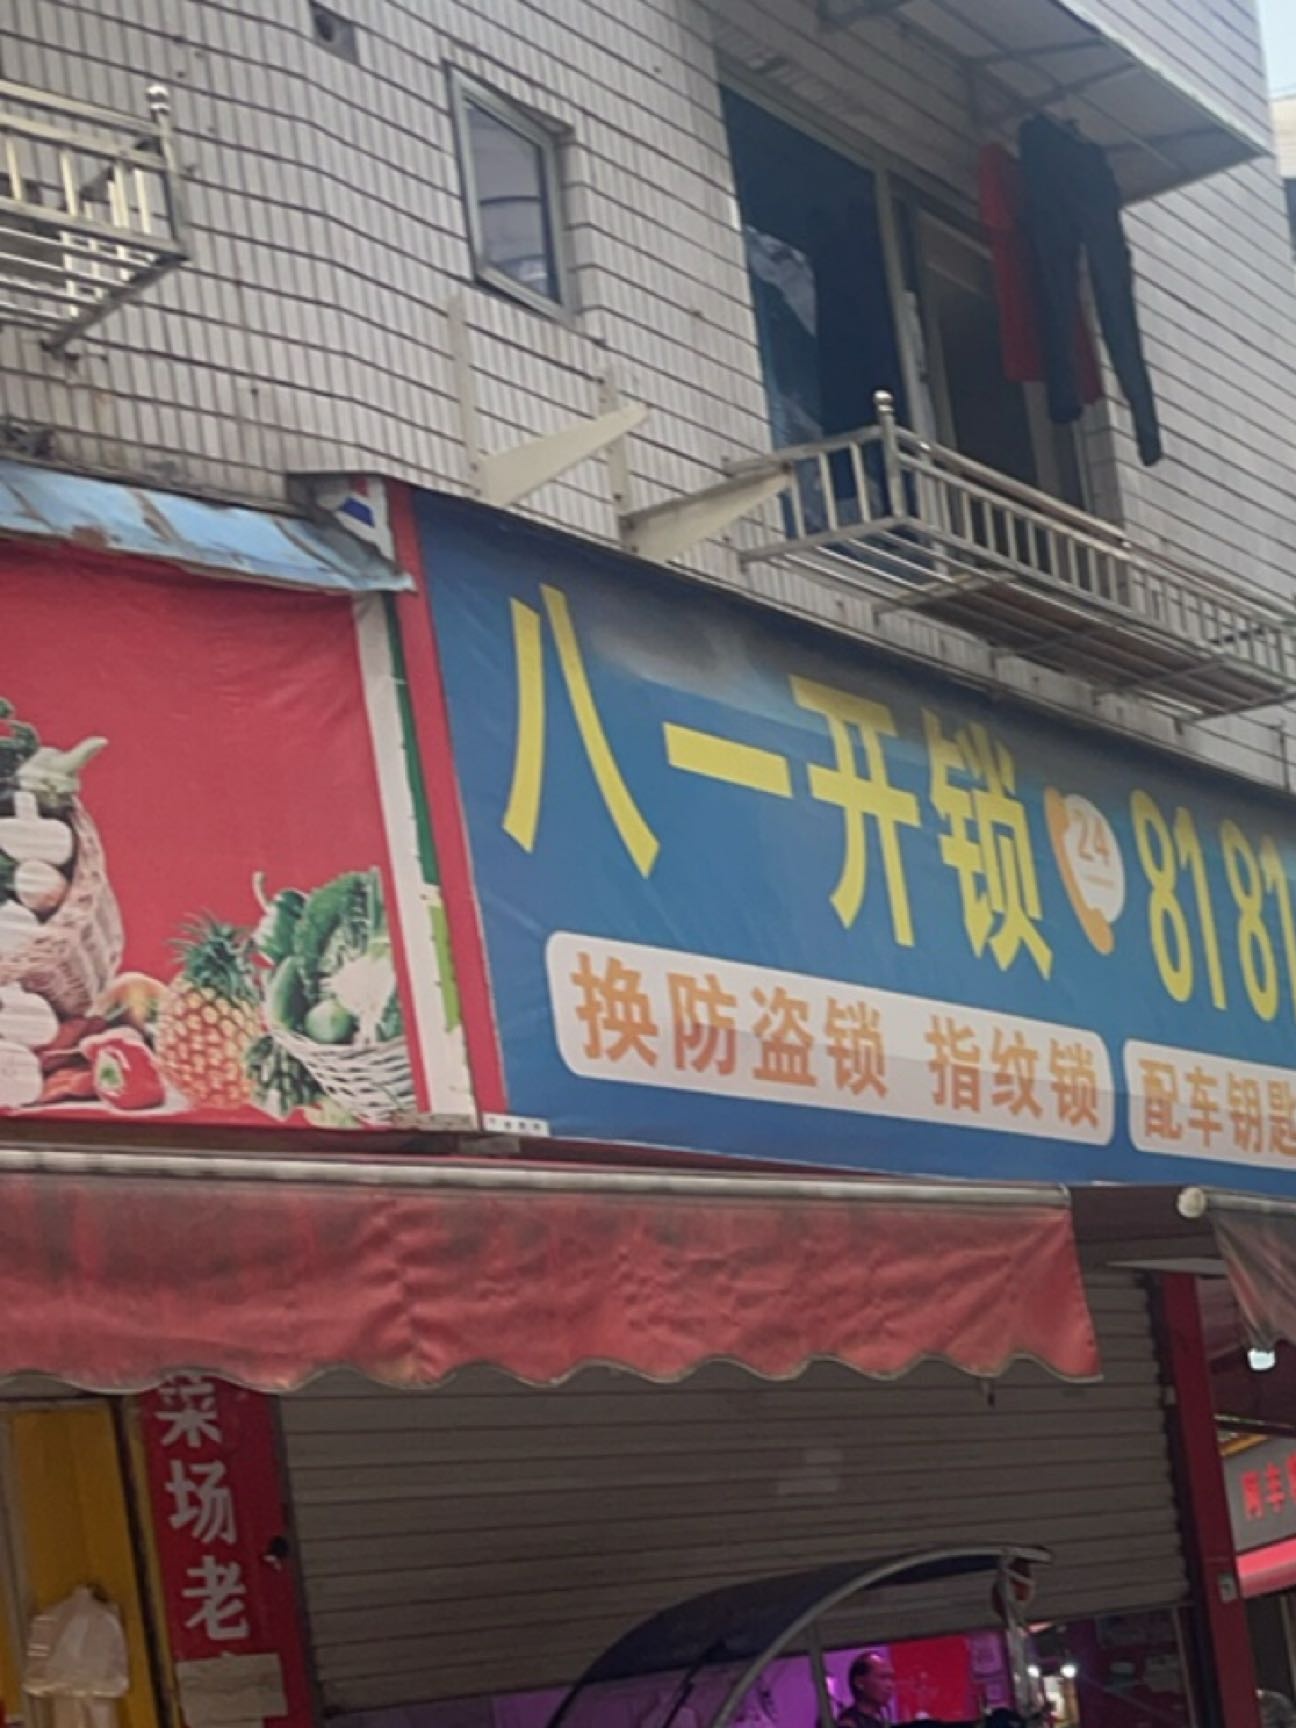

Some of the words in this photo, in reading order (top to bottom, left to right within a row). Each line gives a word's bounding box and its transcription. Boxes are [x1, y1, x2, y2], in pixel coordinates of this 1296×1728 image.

[502, 584, 1053, 980] 八一开锁
[570, 951, 889, 1098] 换防盗锁
[924, 1014, 1101, 1128] 指纹锁
[153, 1374, 251, 1641] 菜场老
